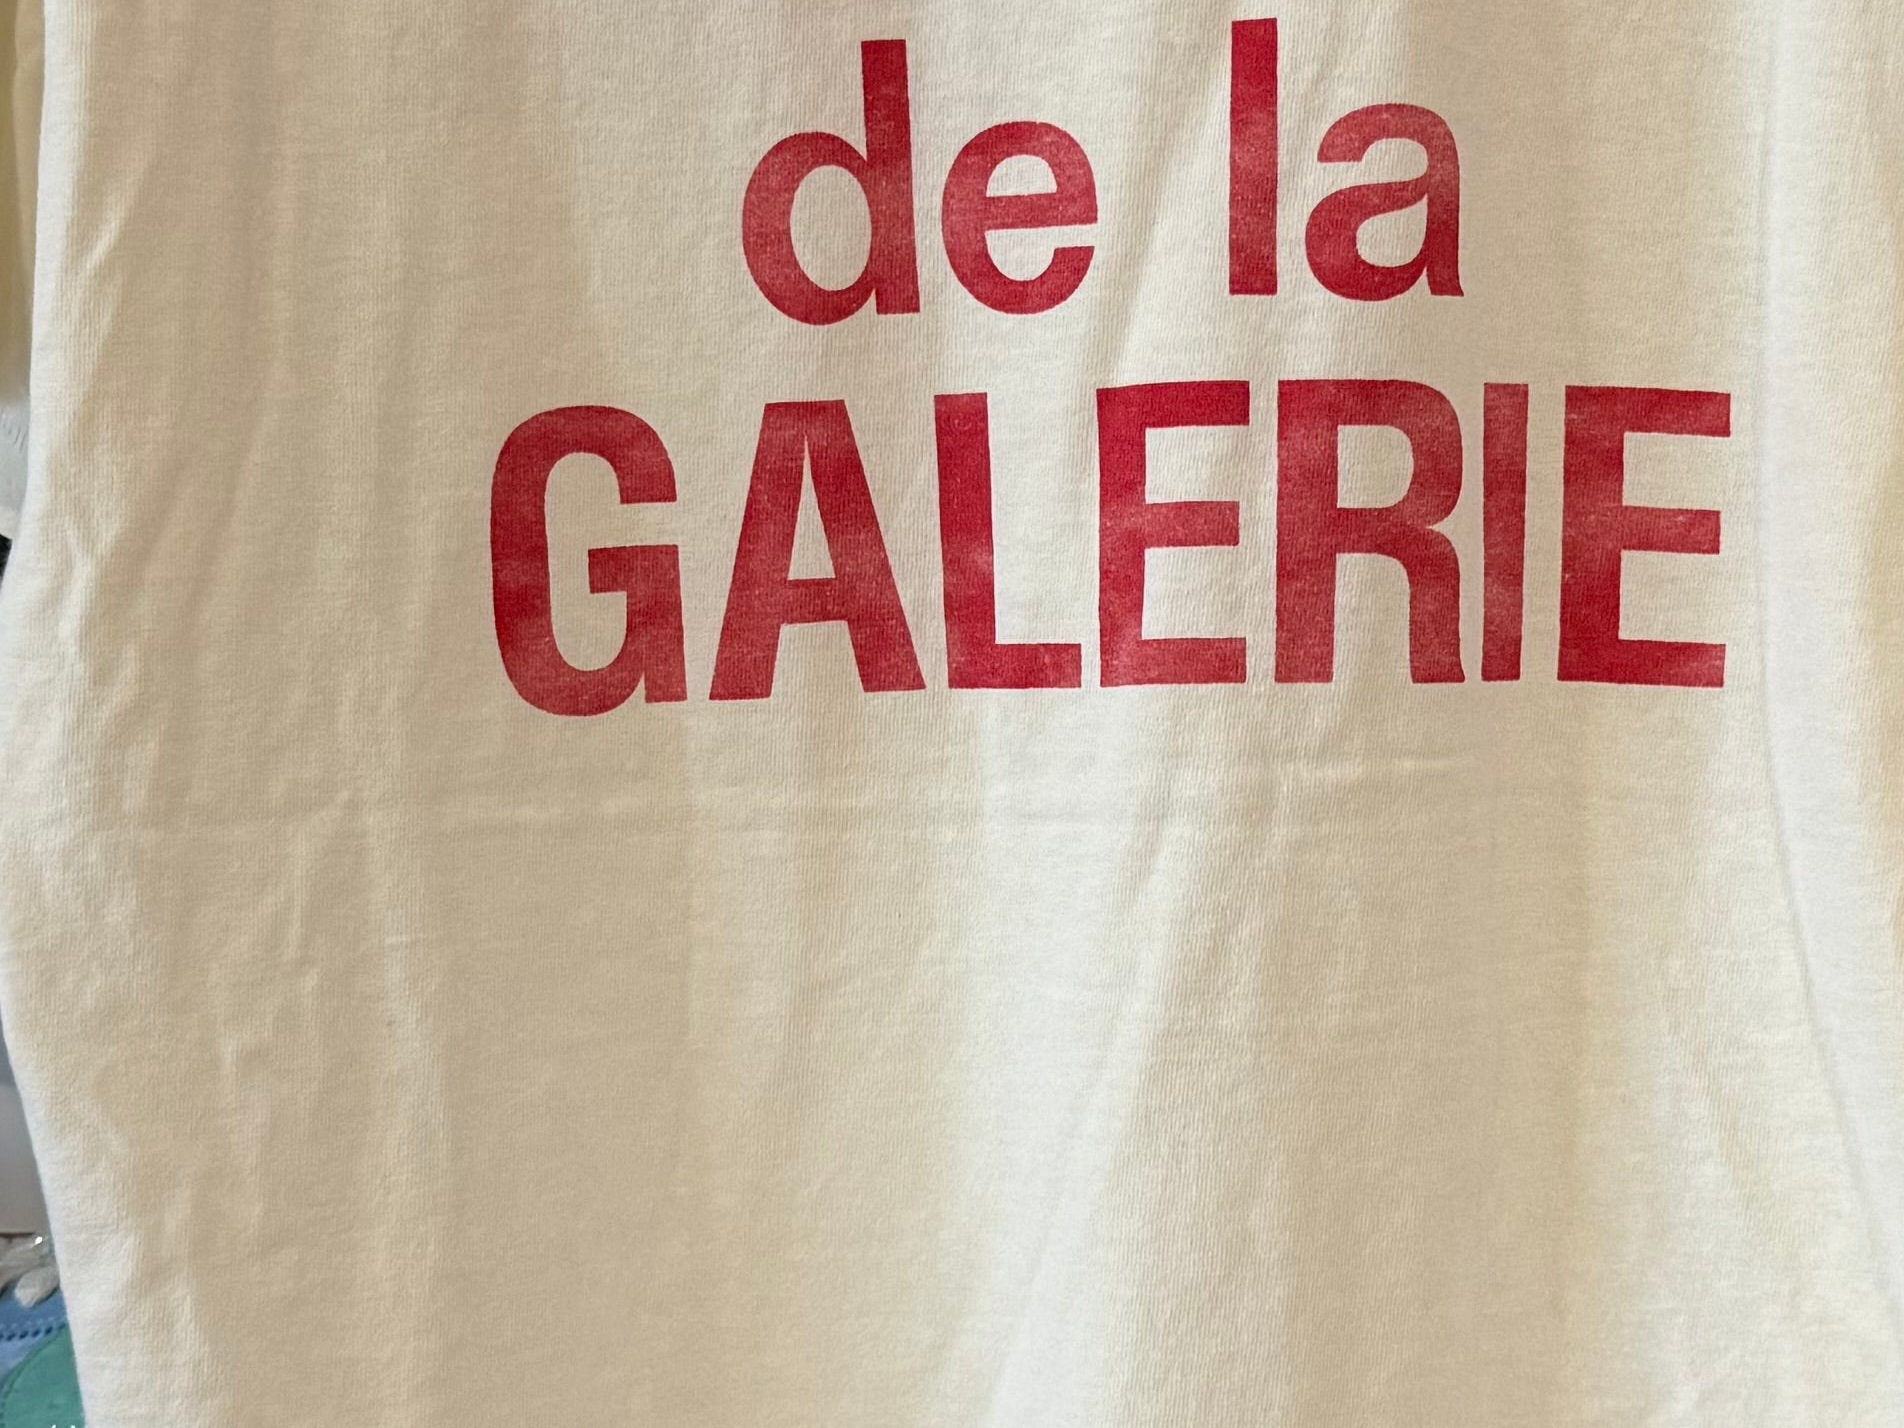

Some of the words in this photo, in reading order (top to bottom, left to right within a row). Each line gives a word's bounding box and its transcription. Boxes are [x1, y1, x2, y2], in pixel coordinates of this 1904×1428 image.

[742, 38, 1098, 326] de
[1228, 17, 1466, 302] la
[489, 378, 1731, 717] GALERIE
